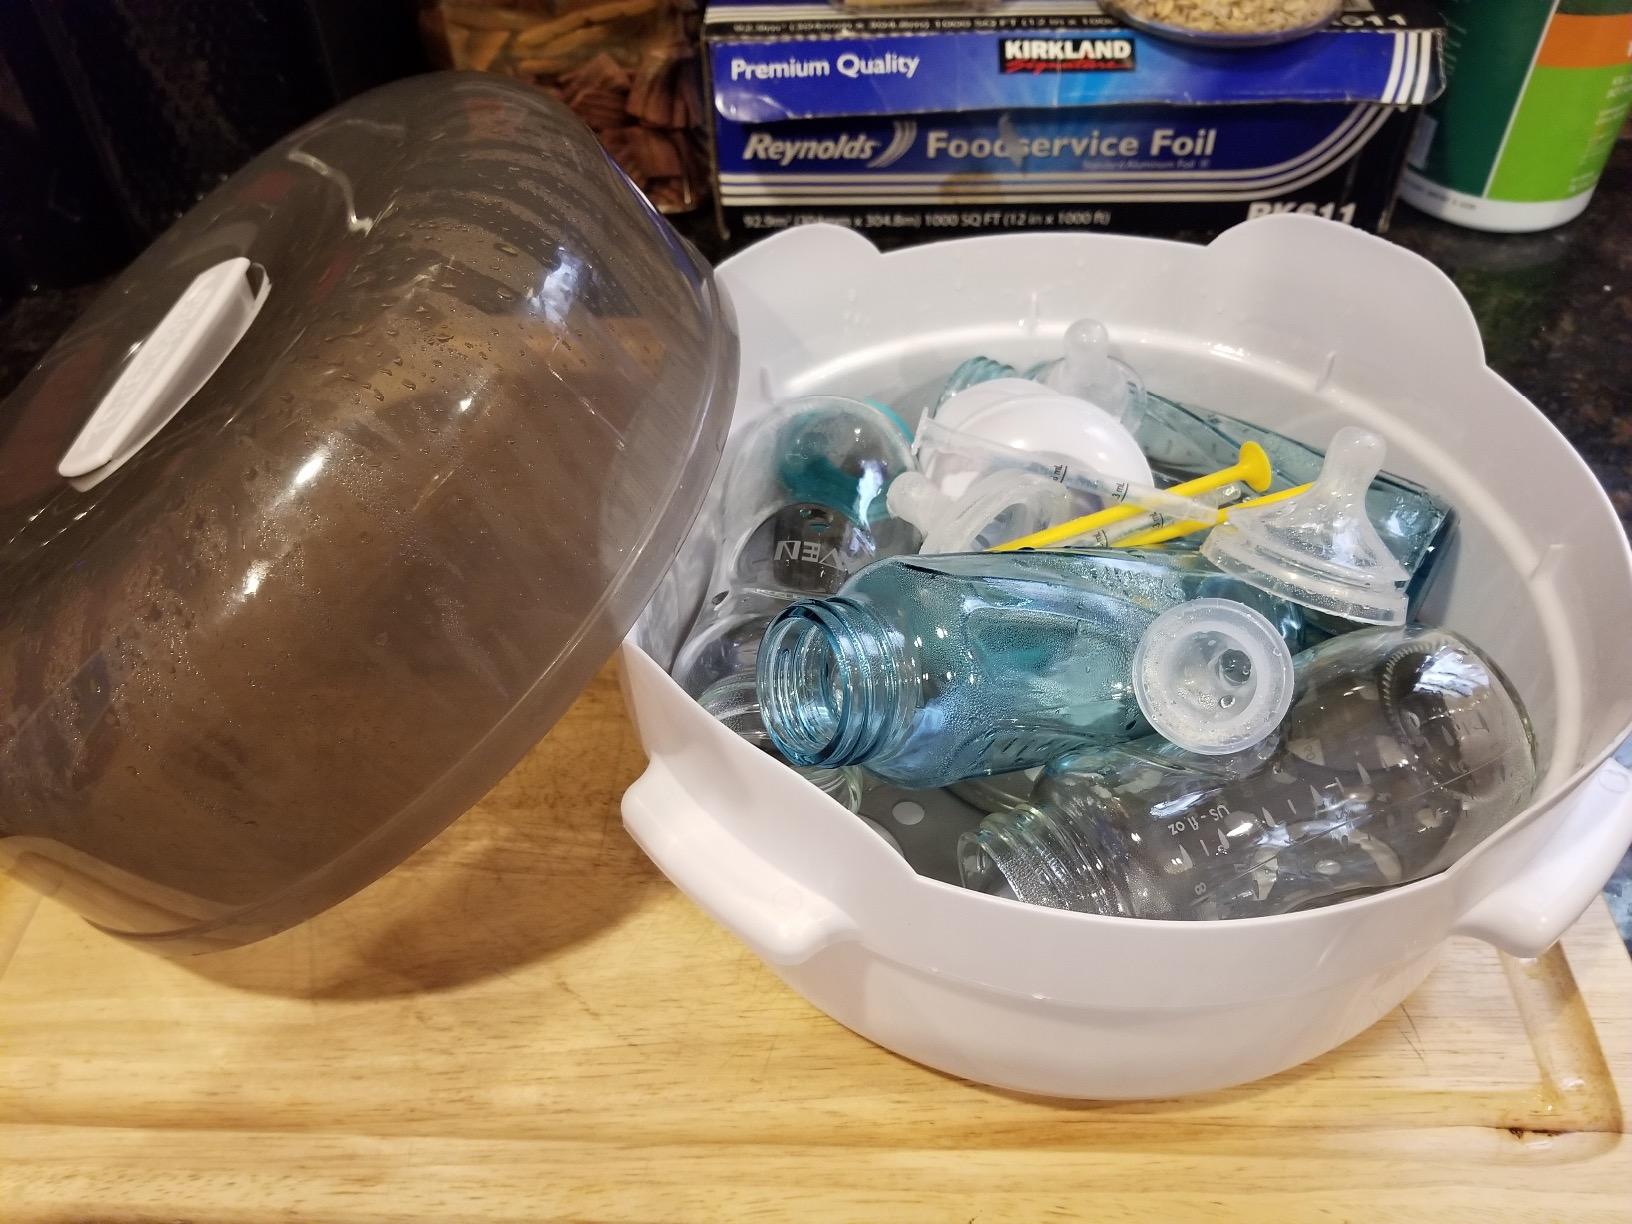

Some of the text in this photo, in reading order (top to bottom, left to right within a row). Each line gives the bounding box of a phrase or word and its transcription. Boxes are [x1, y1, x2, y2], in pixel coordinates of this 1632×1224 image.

[1004, 39, 1132, 60] KIRKLAND
[731, 51, 920, 81] Premium Quality
[743, 132, 876, 166] Reynolds
[1150, 128, 1217, 156] Foil
[925, 212, 960, 227] 1000
[960, 212, 982, 228] SQ
[984, 211, 1001, 226] FT
